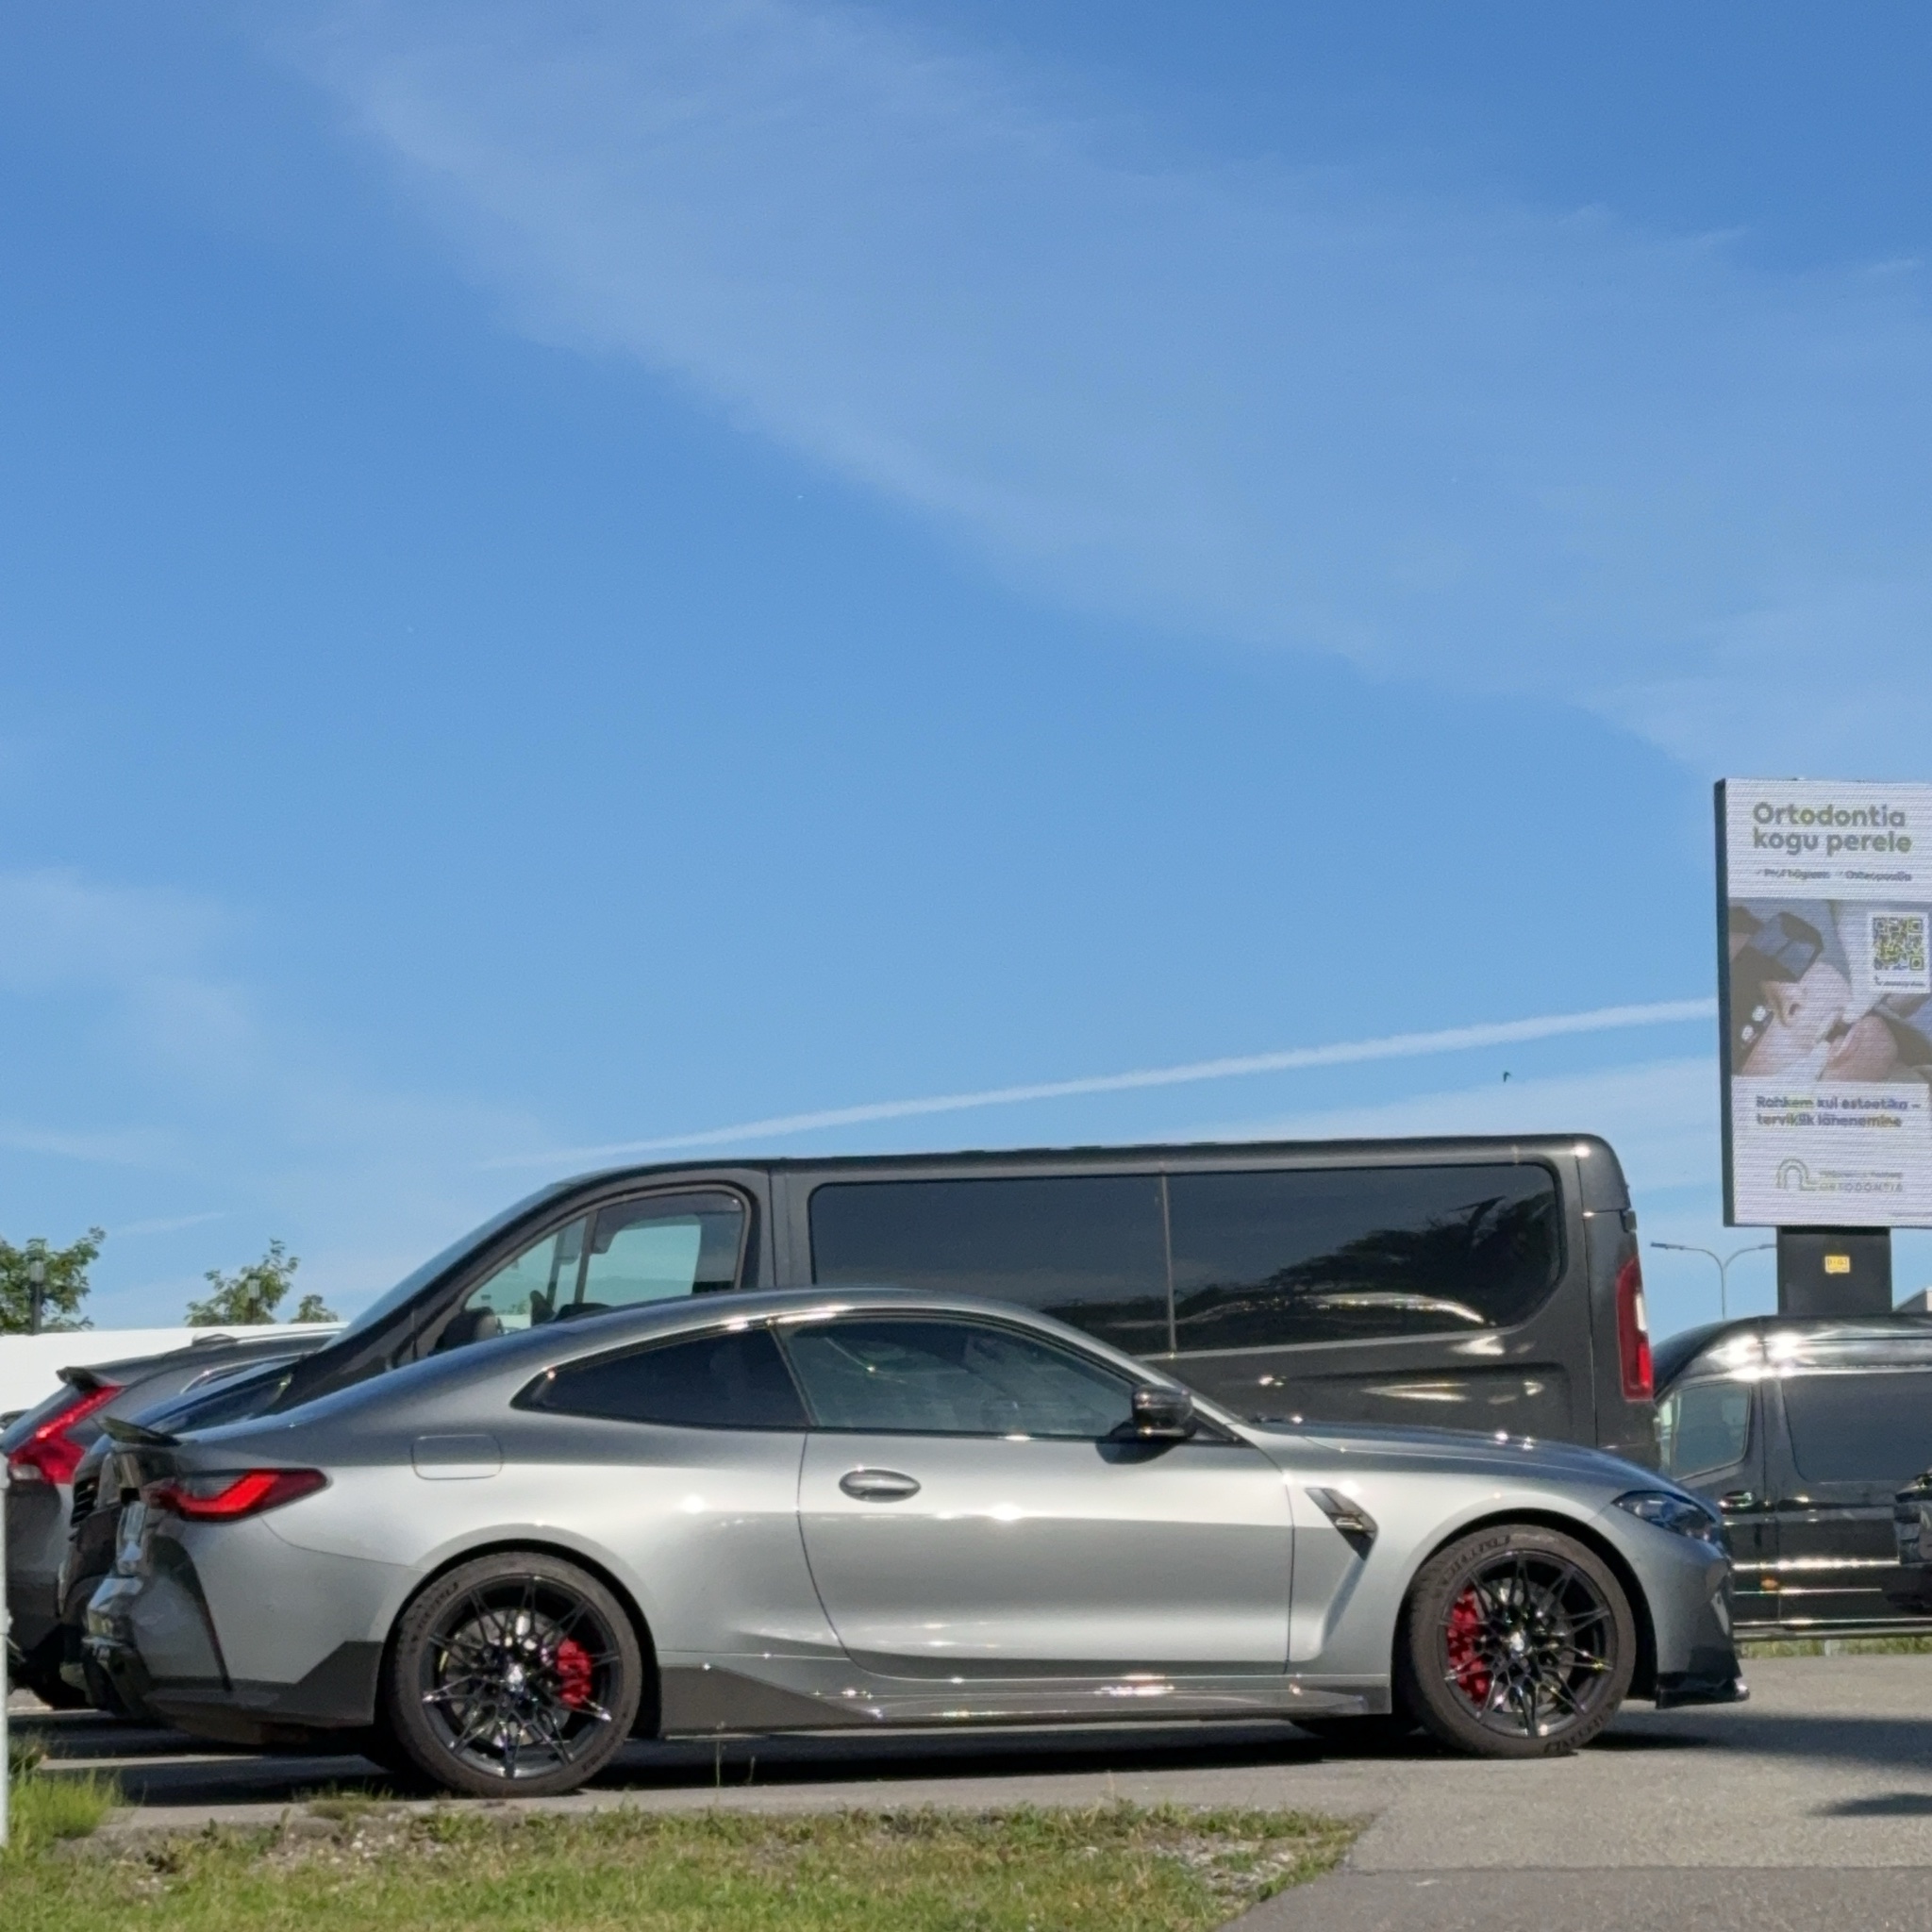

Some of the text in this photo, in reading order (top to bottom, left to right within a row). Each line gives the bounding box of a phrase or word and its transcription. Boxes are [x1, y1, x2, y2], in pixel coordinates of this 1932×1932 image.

[1753, 802, 1906, 827] Ortodontia
[1753, 826, 1913, 857] kogu perele
